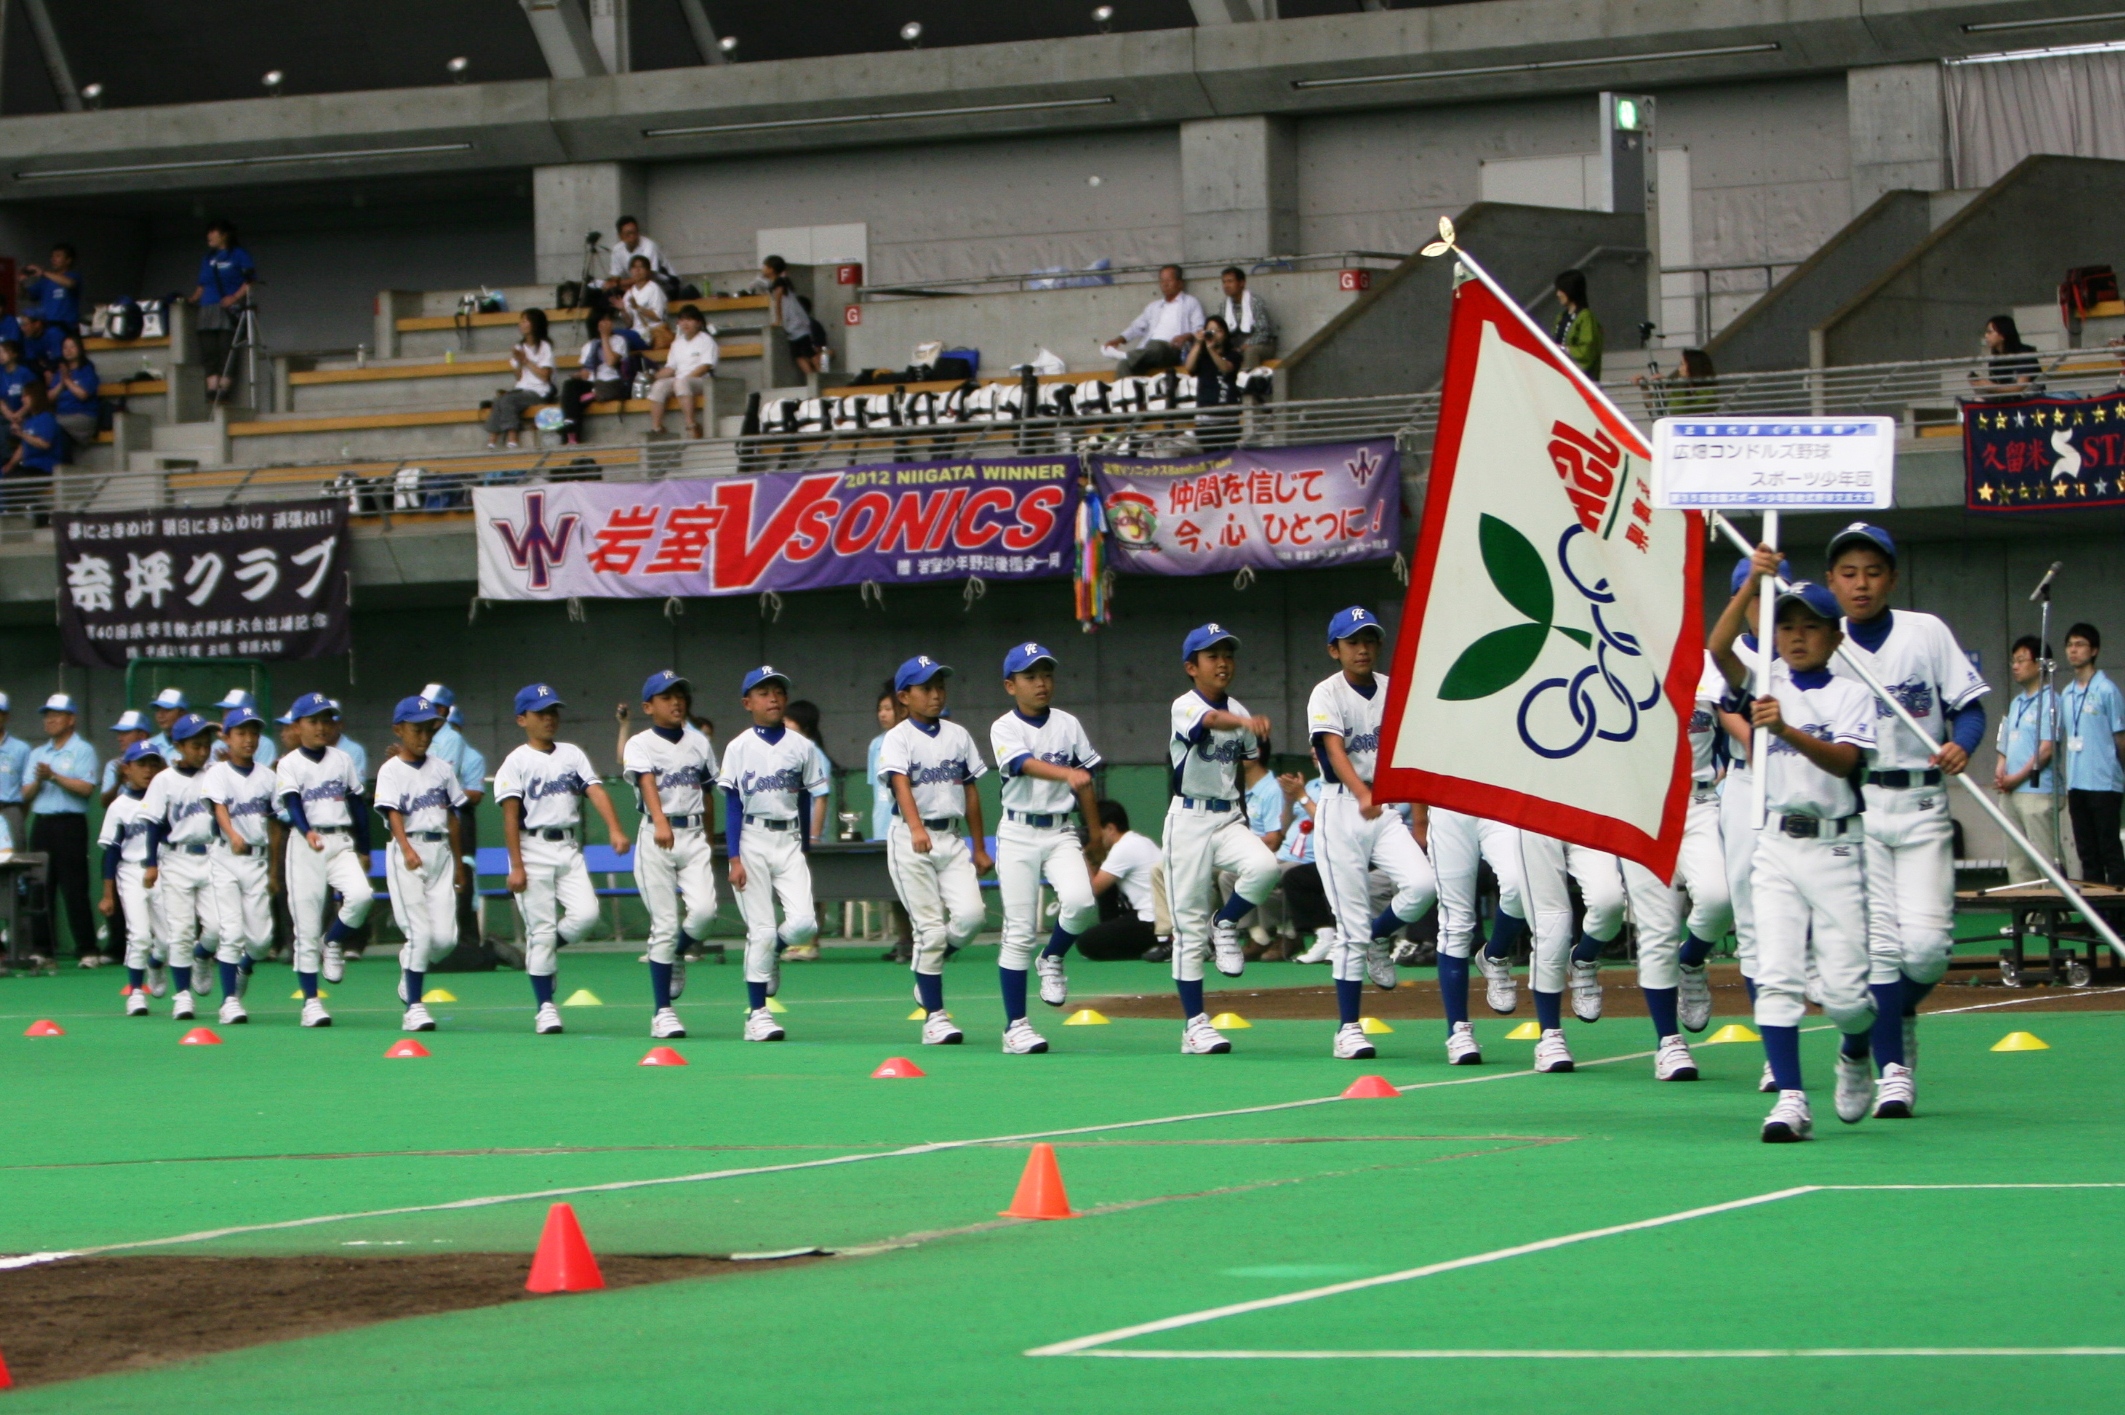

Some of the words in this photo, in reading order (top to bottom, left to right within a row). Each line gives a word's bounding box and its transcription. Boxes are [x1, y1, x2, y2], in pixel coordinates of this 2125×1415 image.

[840, 268, 850, 282] F
[1341, 272, 1353, 288] G
[847, 308, 858, 323] G
[1982, 438, 2049, 473] 久留米
[844, 470, 890, 489] 2012
[897, 465, 976, 485] NIIGATA
[982, 464, 1066, 480] WINNER
[1750, 470, 1873, 487] スポーツ少年団
[1169, 468, 1325, 514] 仲間を信じて
